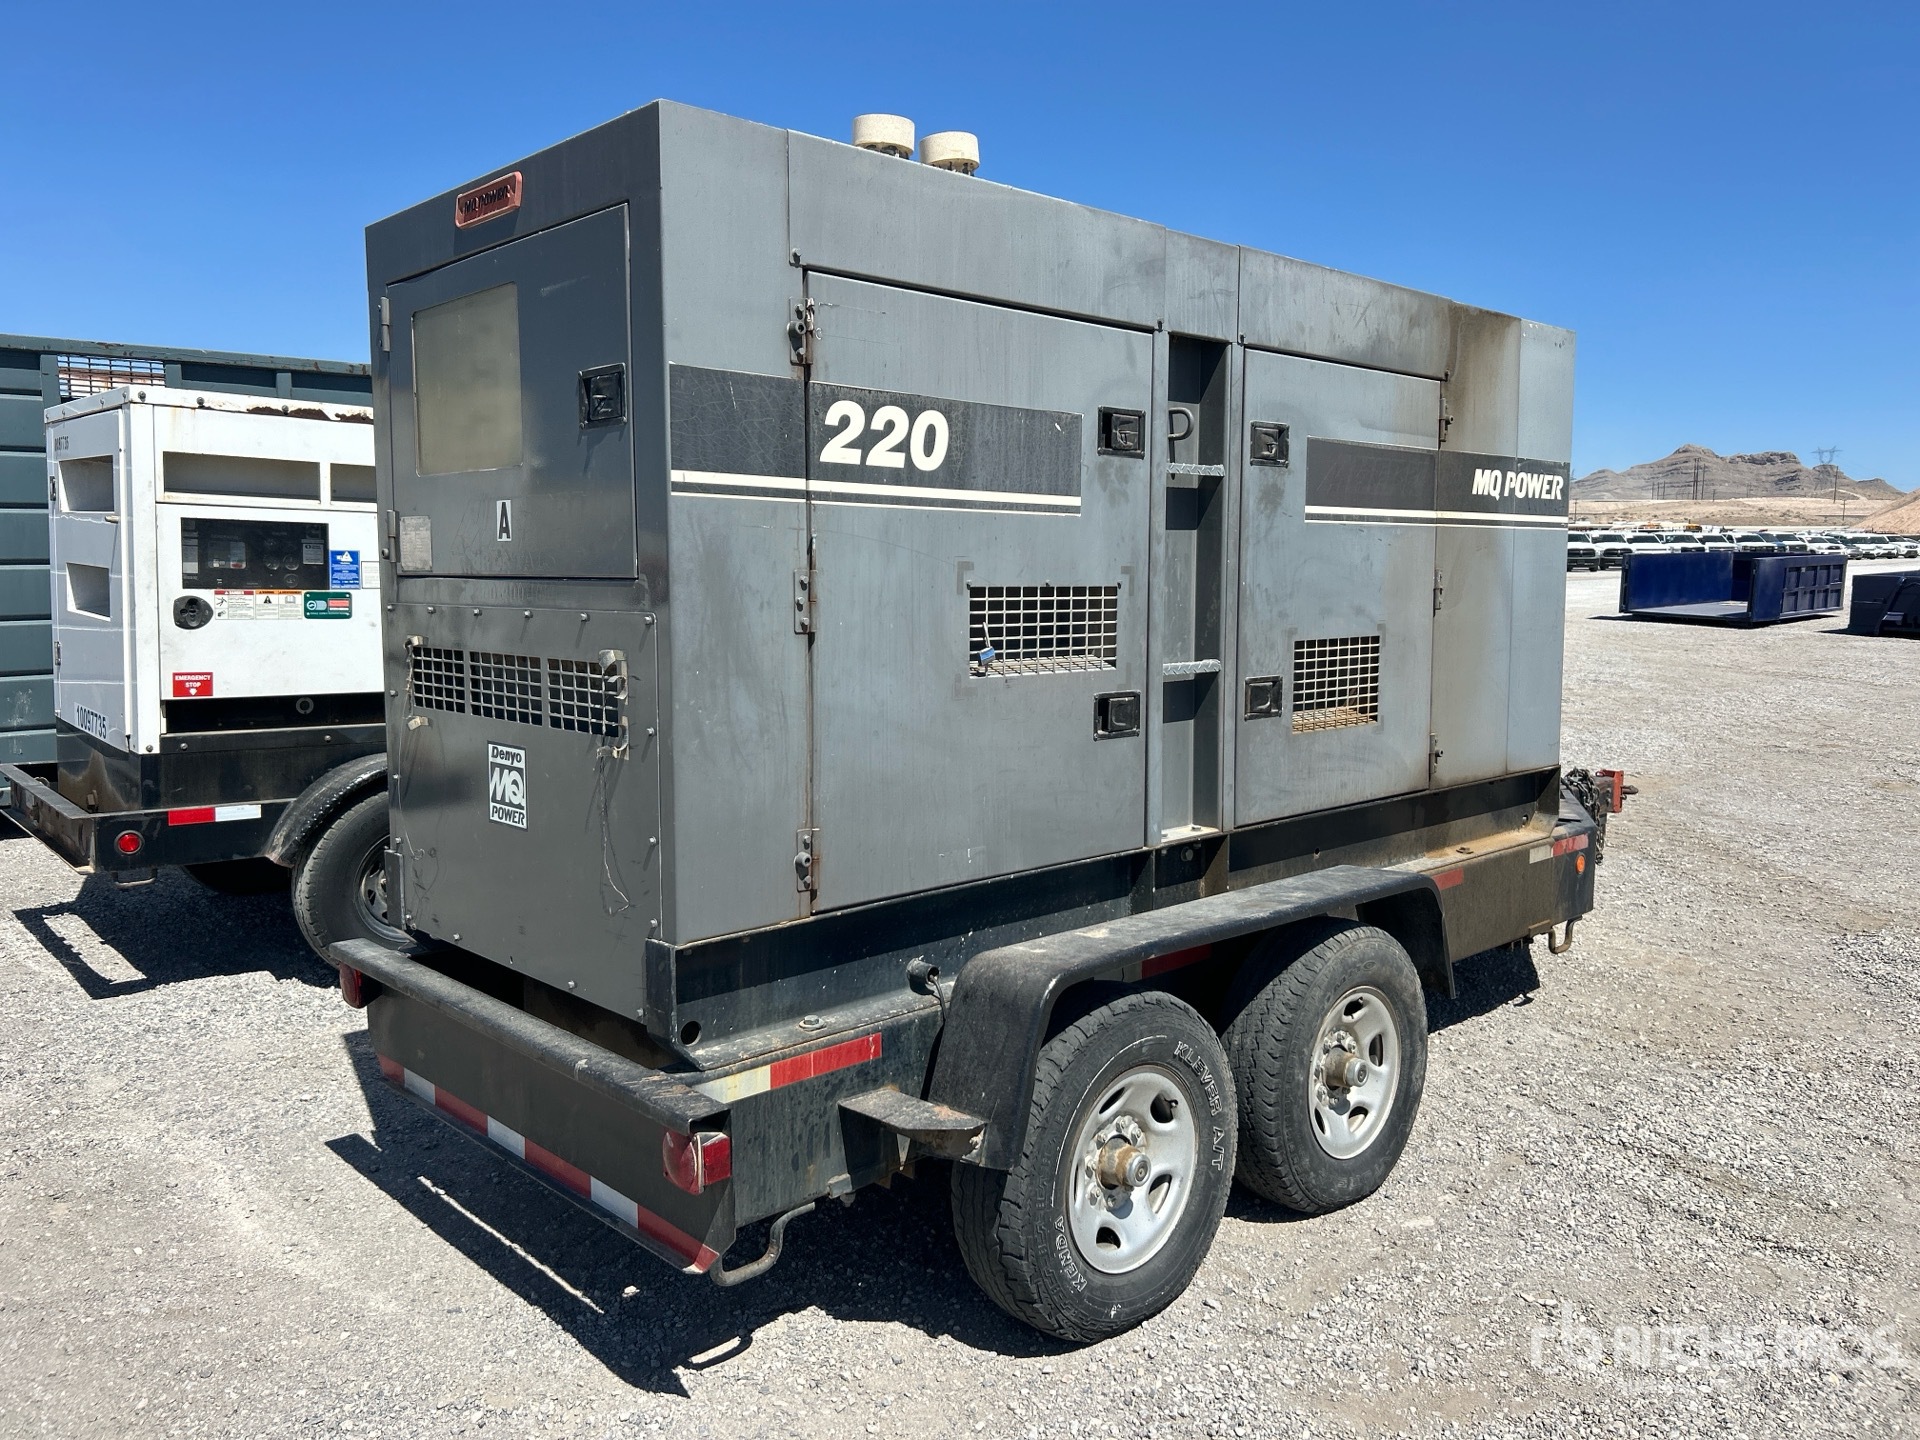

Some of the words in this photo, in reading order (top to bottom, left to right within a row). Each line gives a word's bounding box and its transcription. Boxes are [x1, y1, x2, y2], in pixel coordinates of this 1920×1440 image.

[820, 400, 949, 471] 220
[1472, 469, 1502, 500] MQ
[1504, 471, 1564, 500] POWER
[498, 501, 511, 540] A
[76, 705, 107, 739] 10097735
[491, 746, 522, 765] Denyo
[490, 767, 526, 807] MQ
[492, 805, 525, 825] POWER
[1174, 1041, 1222, 1116] KLEVER
[1212, 1126, 1225, 1171] A/T
[1055, 1216, 1087, 1292] KENDA
